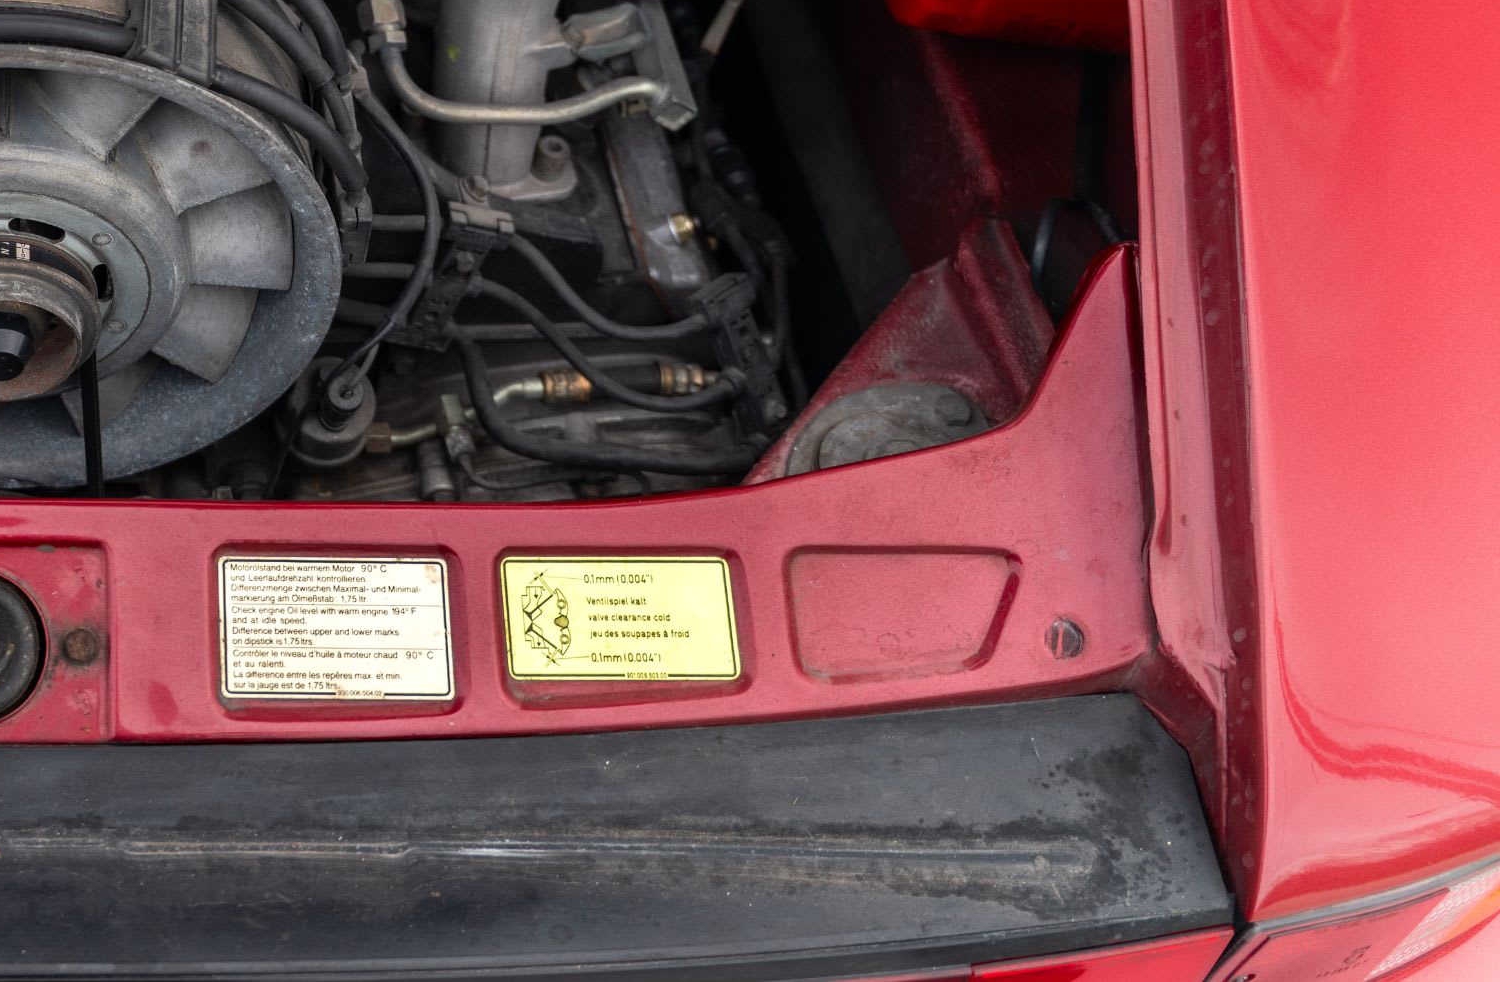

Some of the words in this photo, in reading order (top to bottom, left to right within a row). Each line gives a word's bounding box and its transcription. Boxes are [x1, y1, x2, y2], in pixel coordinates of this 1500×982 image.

[283, 564, 294, 572] bei
[231, 584, 292, 593] Differenzmenge
[333, 585, 369, 593] Maximal-
[231, 595, 275, 604] markierung
[586, 597, 628, 606] Ventilspiel
[631, 597, 646, 605] kalt
[232, 606, 256, 614] Check
[258, 607, 285, 615] engine
[287, 606, 298, 614] Oil
[320, 607, 336, 615] with
[362, 609, 388, 617] engine
[411, 607, 416, 615] F
[611, 613, 651, 621] clearance
[653, 613, 670, 621] cold
[352, 628, 372, 636] lower
[590, 629, 602, 639] jeu
[604, 629, 619, 637] des
[621, 630, 660, 639] soupapes
[663, 629, 668, 637] à
[671, 629, 690, 638] froid
[244, 638, 273, 646] dipstick
[233, 649, 269, 657] Contrôler
[280, 650, 306, 658] niveau
[308, 650, 334, 658] d'huile
[427, 651, 434, 659] C
[233, 660, 241, 668] et
[257, 682, 279, 690] jauge
